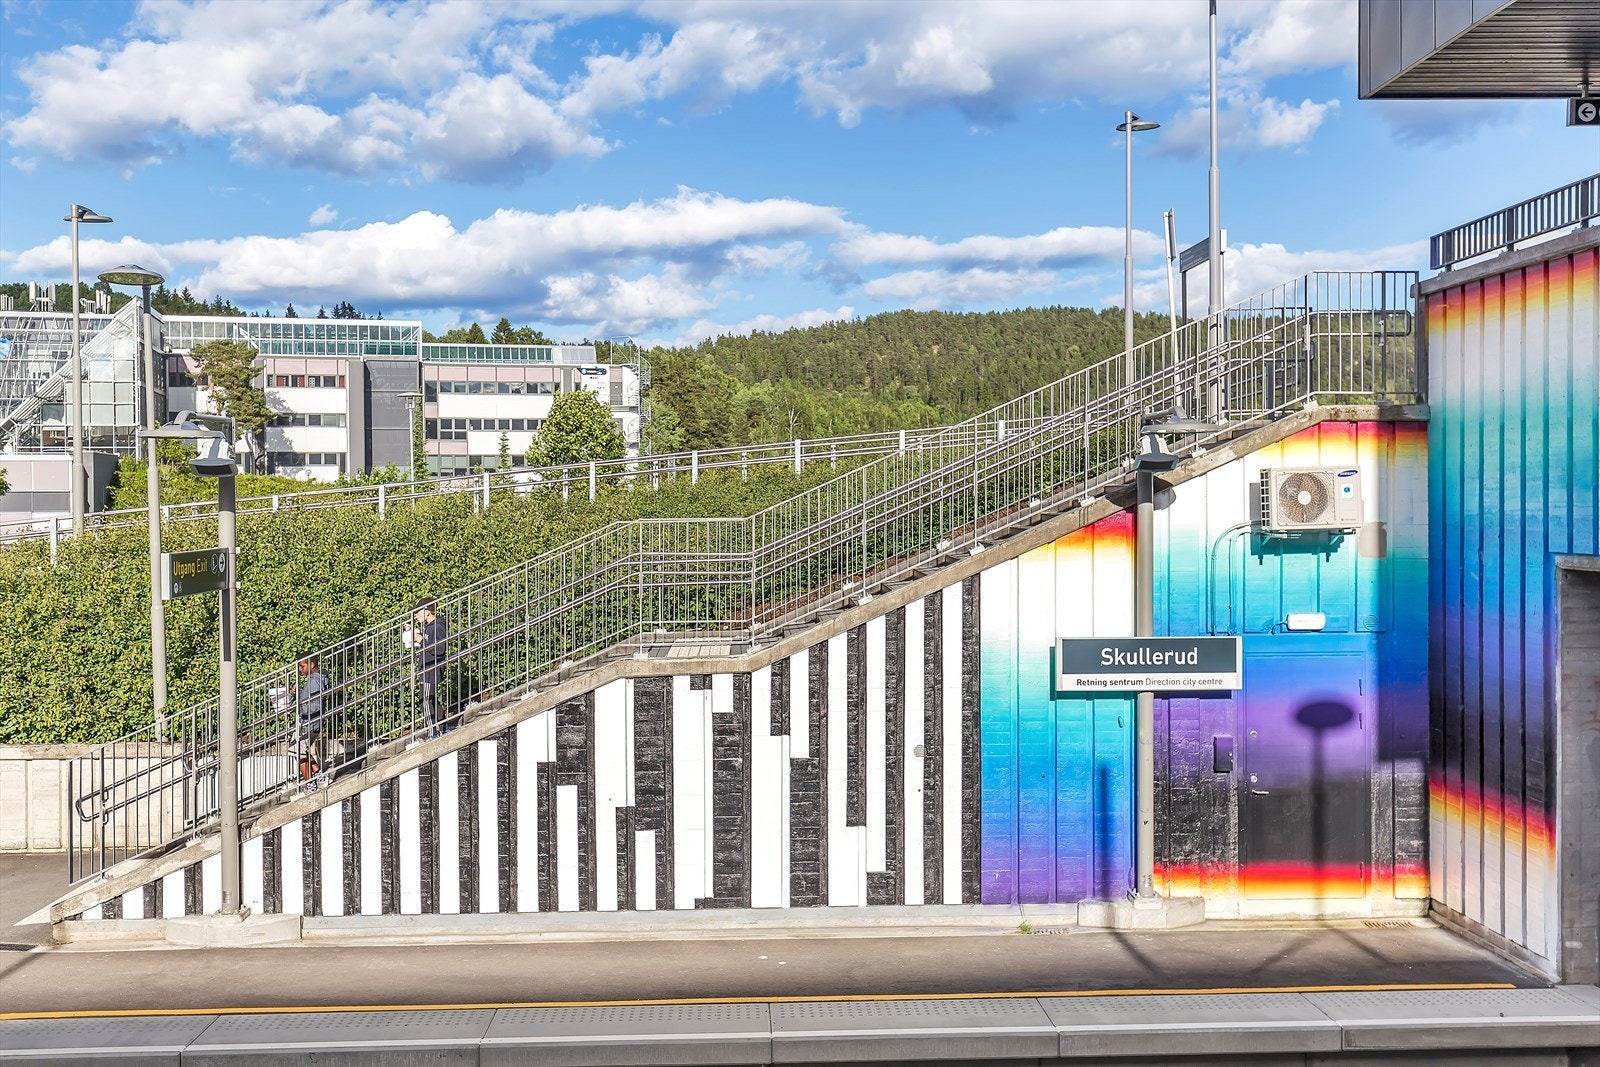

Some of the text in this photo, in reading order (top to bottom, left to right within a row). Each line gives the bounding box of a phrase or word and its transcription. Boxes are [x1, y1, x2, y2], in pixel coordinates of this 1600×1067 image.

[173, 558, 208, 579] Utgang Exit
[1101, 647, 1198, 665] Skullerud
[1076, 678, 1107, 687] Retning
[1145, 677, 1181, 686] Direction
[1182, 678, 1196, 687] city
[1198, 678, 1223, 686] centre
